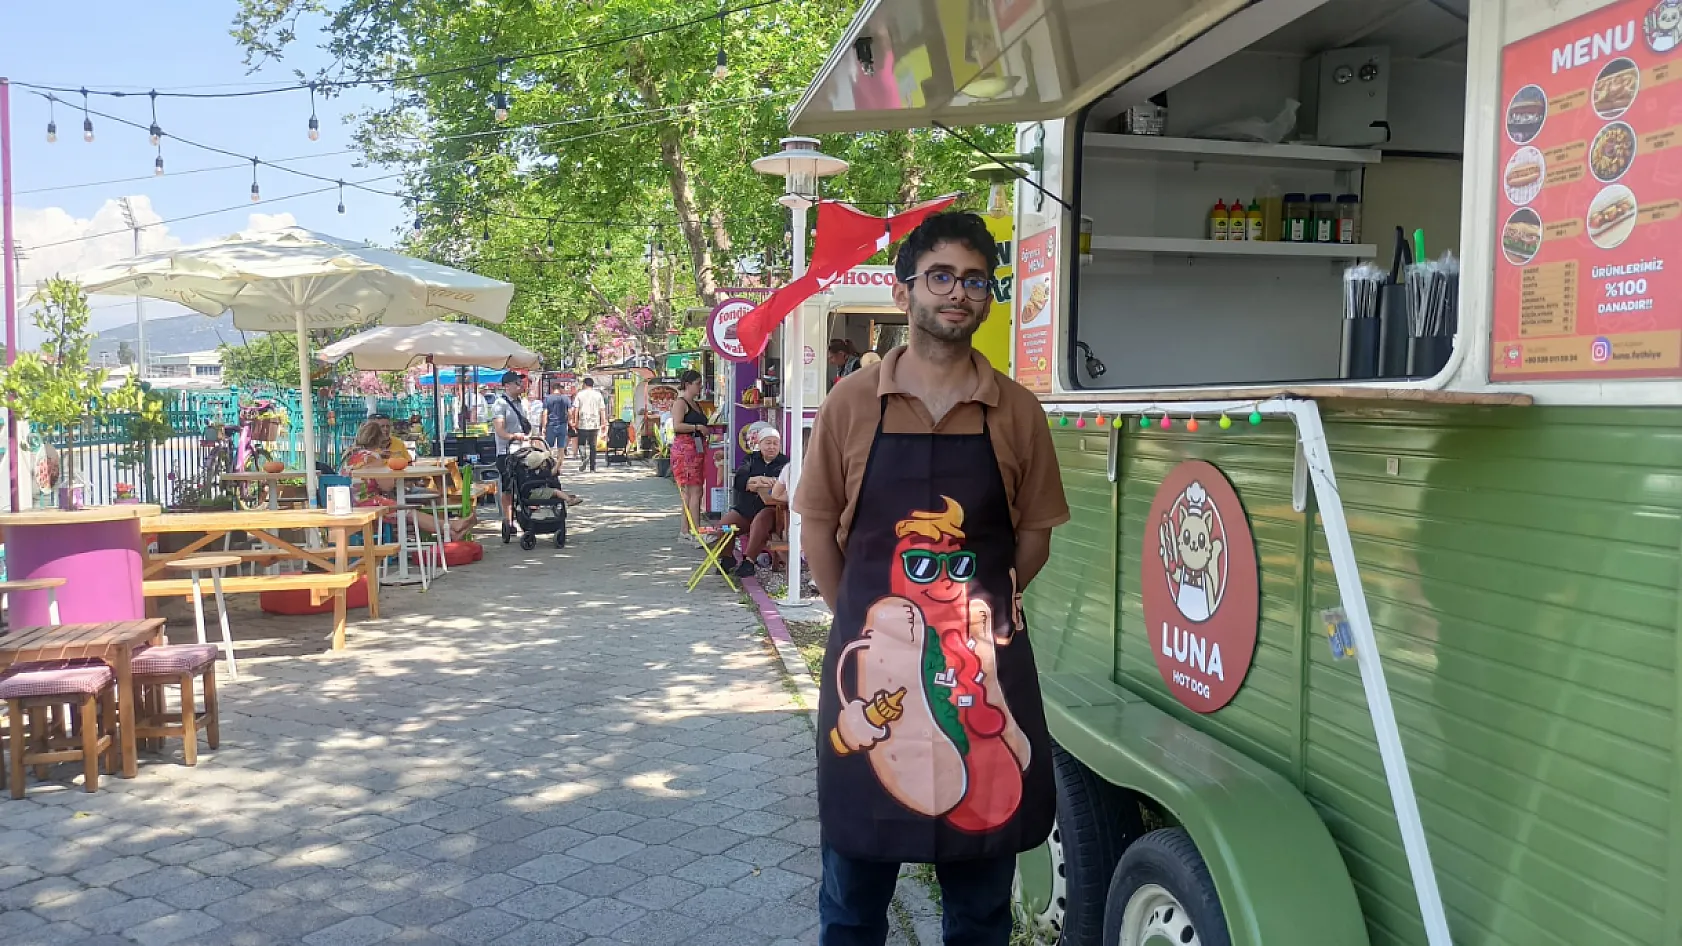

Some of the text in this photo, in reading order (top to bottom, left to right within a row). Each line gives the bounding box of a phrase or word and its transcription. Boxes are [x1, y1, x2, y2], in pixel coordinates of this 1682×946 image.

[1551, 20, 1635, 74] MENU
[1592, 256, 1664, 278] ÜRÜNLERİMİZ
[1605, 278, 1647, 298] %100
[1597, 298, 1653, 314] DANADIR!!
[1162, 622, 1224, 681] LUNA
[1172, 669, 1210, 699] HOT DOG
